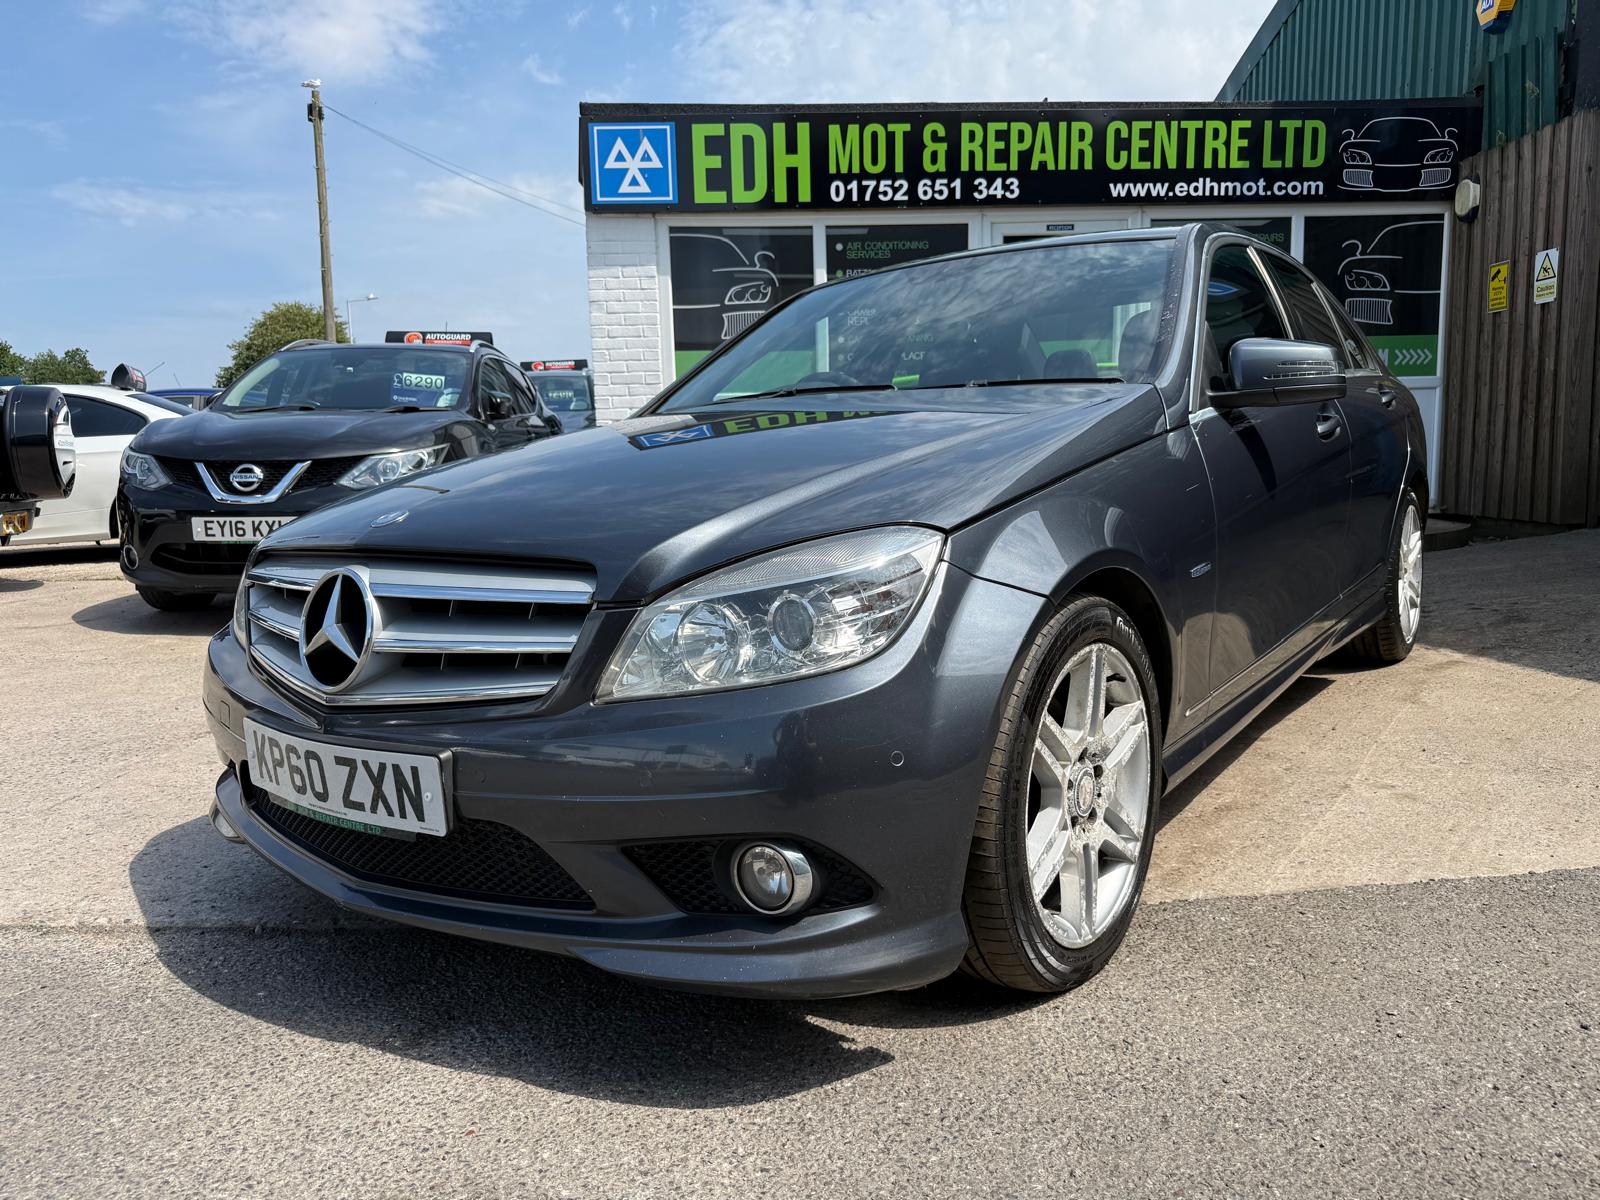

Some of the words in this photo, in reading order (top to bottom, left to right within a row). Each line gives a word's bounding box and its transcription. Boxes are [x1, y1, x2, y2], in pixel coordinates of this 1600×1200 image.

[691, 121, 812, 204] EDH
[828, 123, 911, 175] MOT
[922, 122, 948, 173] &
[960, 121, 1094, 172] REPAIR
[1106, 120, 1252, 171] CENTRE
[1263, 119, 1327, 169] LTD
[829, 179, 909, 202] 01752
[917, 178, 962, 201] 651
[973, 177, 1021, 199] 343
[1109, 178, 1325, 198] www.edhmot.com
[846, 241, 862, 250] AIR
[864, 241, 929, 250] CONDITIONING
[846, 250, 891, 259] SERVICES
[425, 333, 472, 341] AUTOGUARD
[203, 520, 247, 537] EY16
[252, 730, 330, 803] KP60
[334, 755, 426, 823] ZXN
[340, 817, 365, 832] CENTRE
[367, 824, 381, 834] LTD
